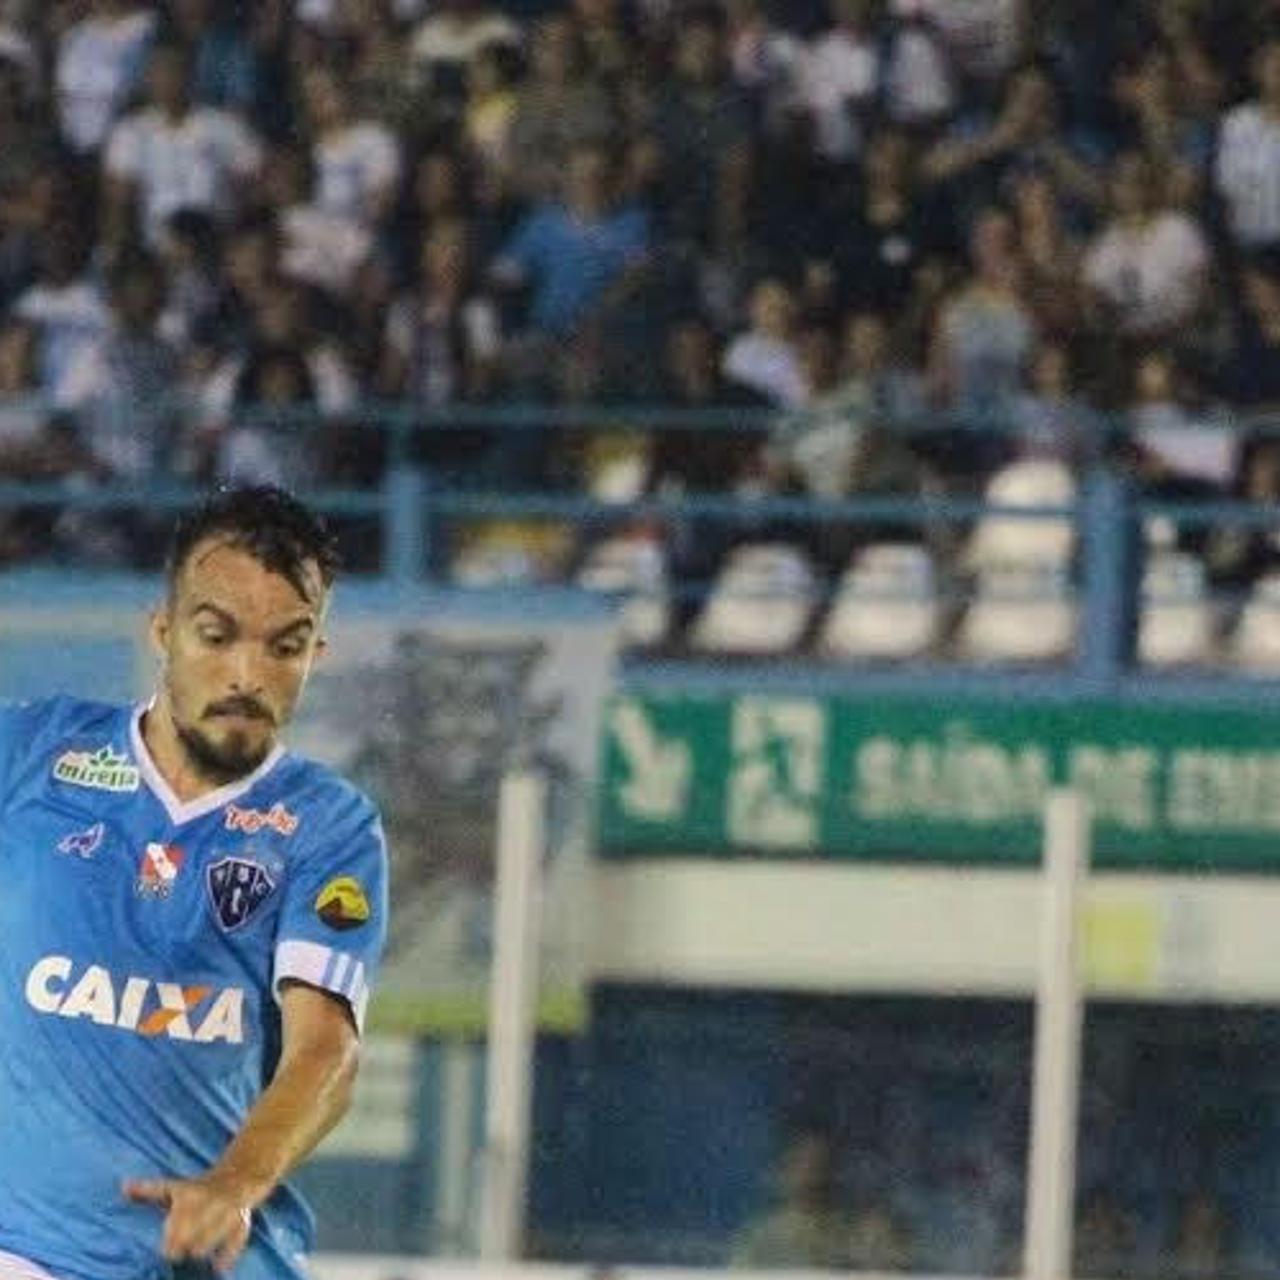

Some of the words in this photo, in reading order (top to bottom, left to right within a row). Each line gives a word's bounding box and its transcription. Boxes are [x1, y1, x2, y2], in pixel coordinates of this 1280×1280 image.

[855, 721, 1046, 823] SAÍDA
[1070, 743, 1161, 832] DE
[25, 955, 244, 1044] CAIXA
